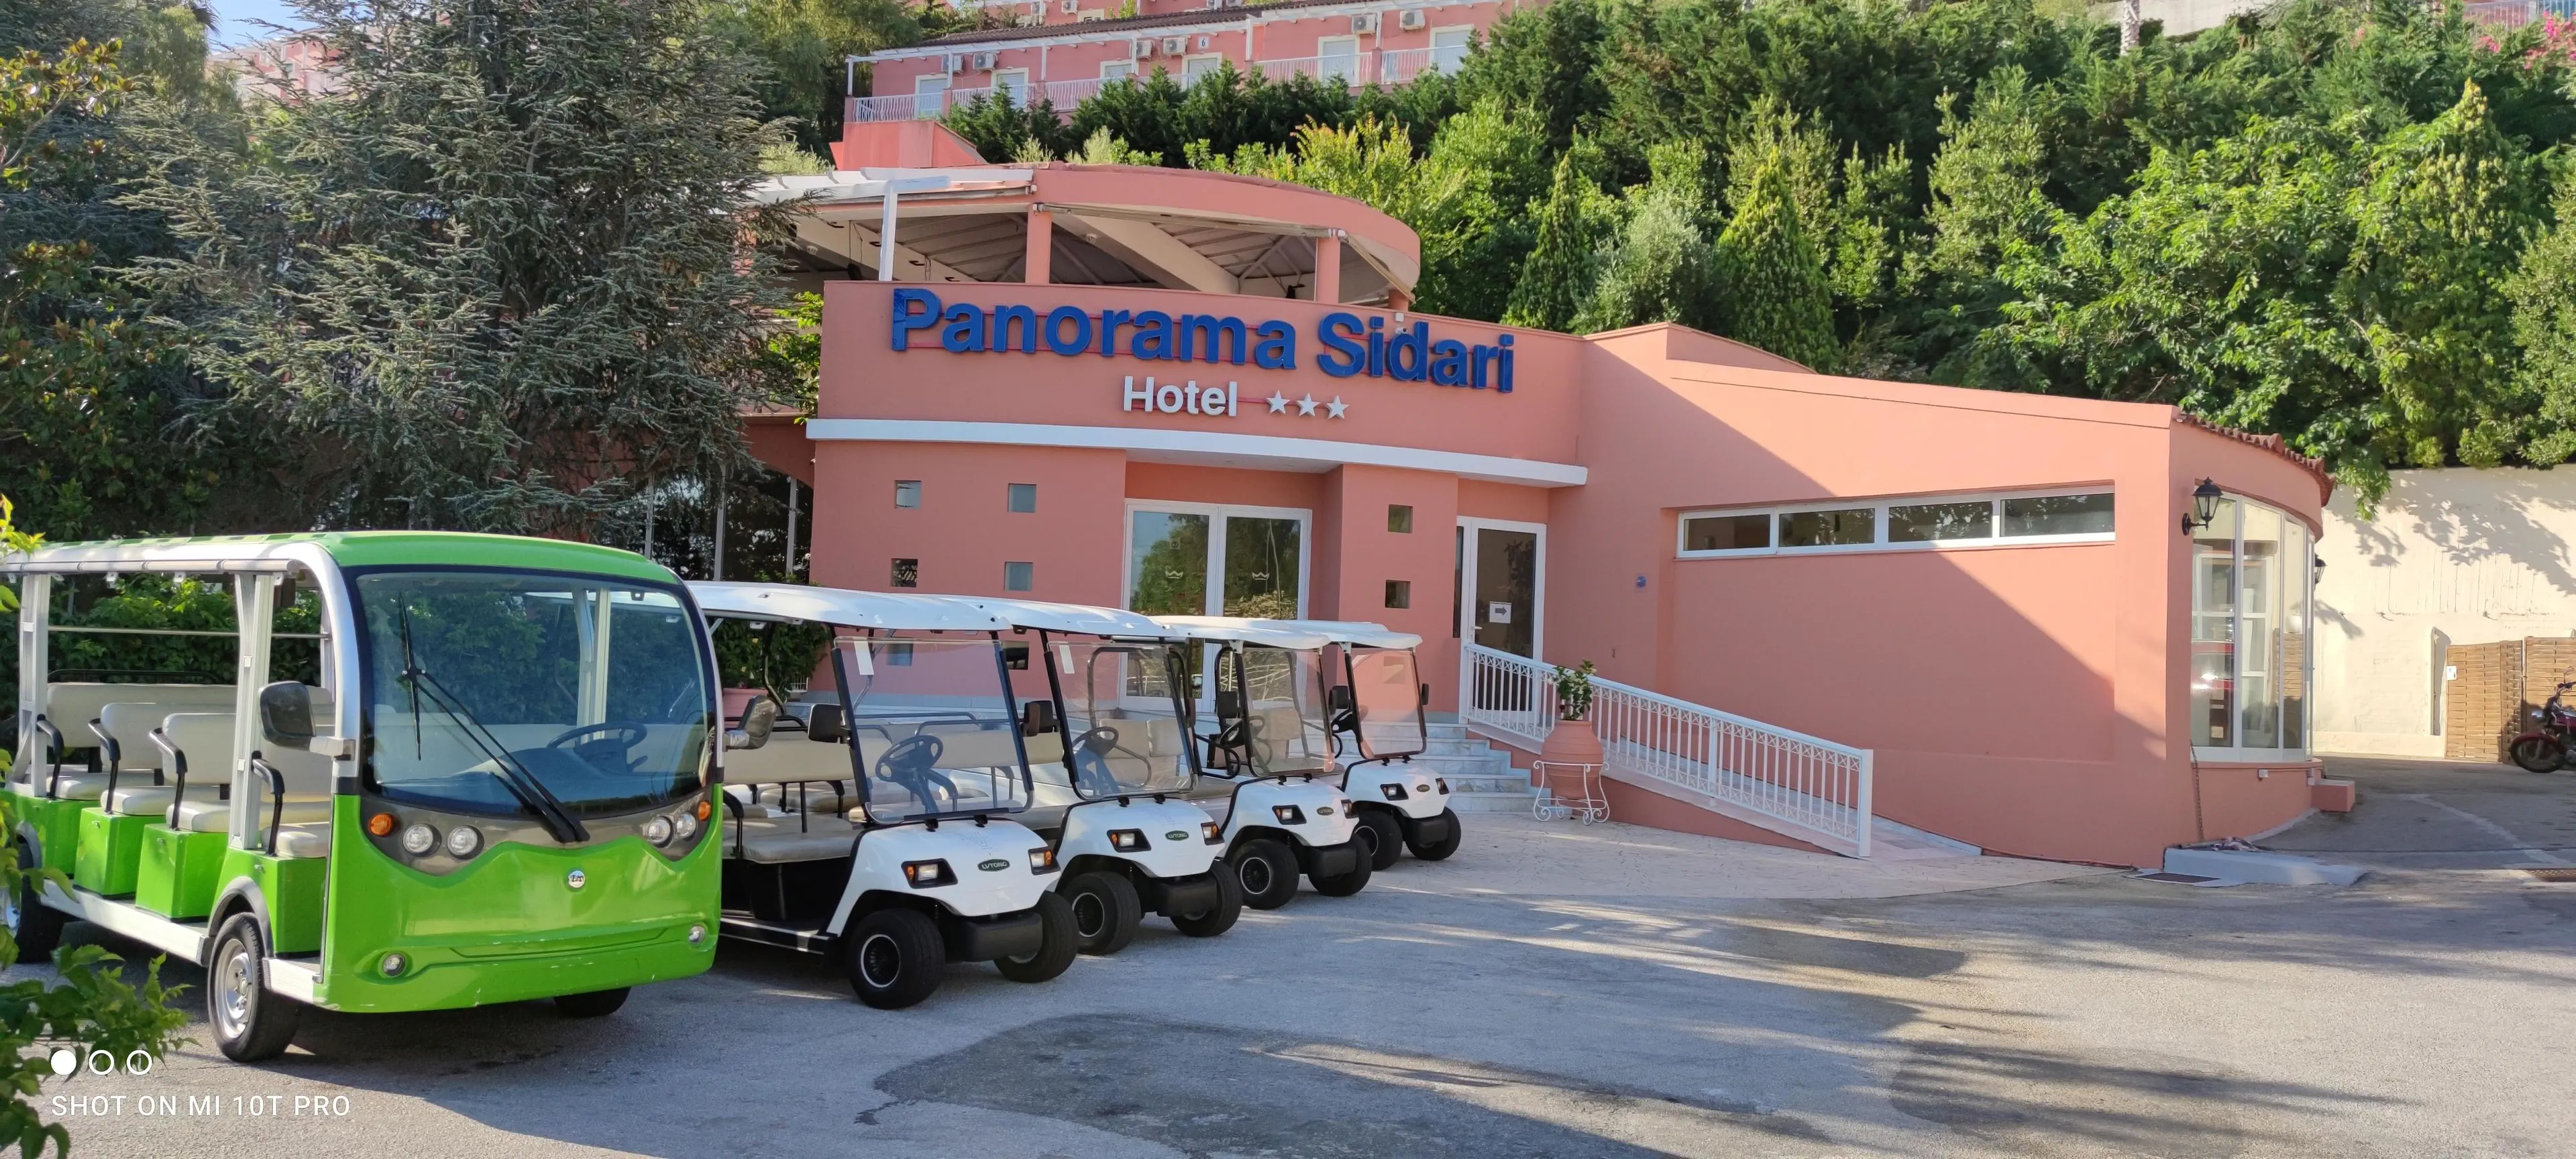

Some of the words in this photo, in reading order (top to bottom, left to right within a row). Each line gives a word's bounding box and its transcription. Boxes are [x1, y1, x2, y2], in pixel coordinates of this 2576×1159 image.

[1201, 38, 1206, 47] 6
[890, 287, 1297, 370] Panorama
[1317, 312, 1515, 394] Sidari
[1123, 375, 1238, 417] Hotel
[981, 861, 1007, 869] LVTONG
